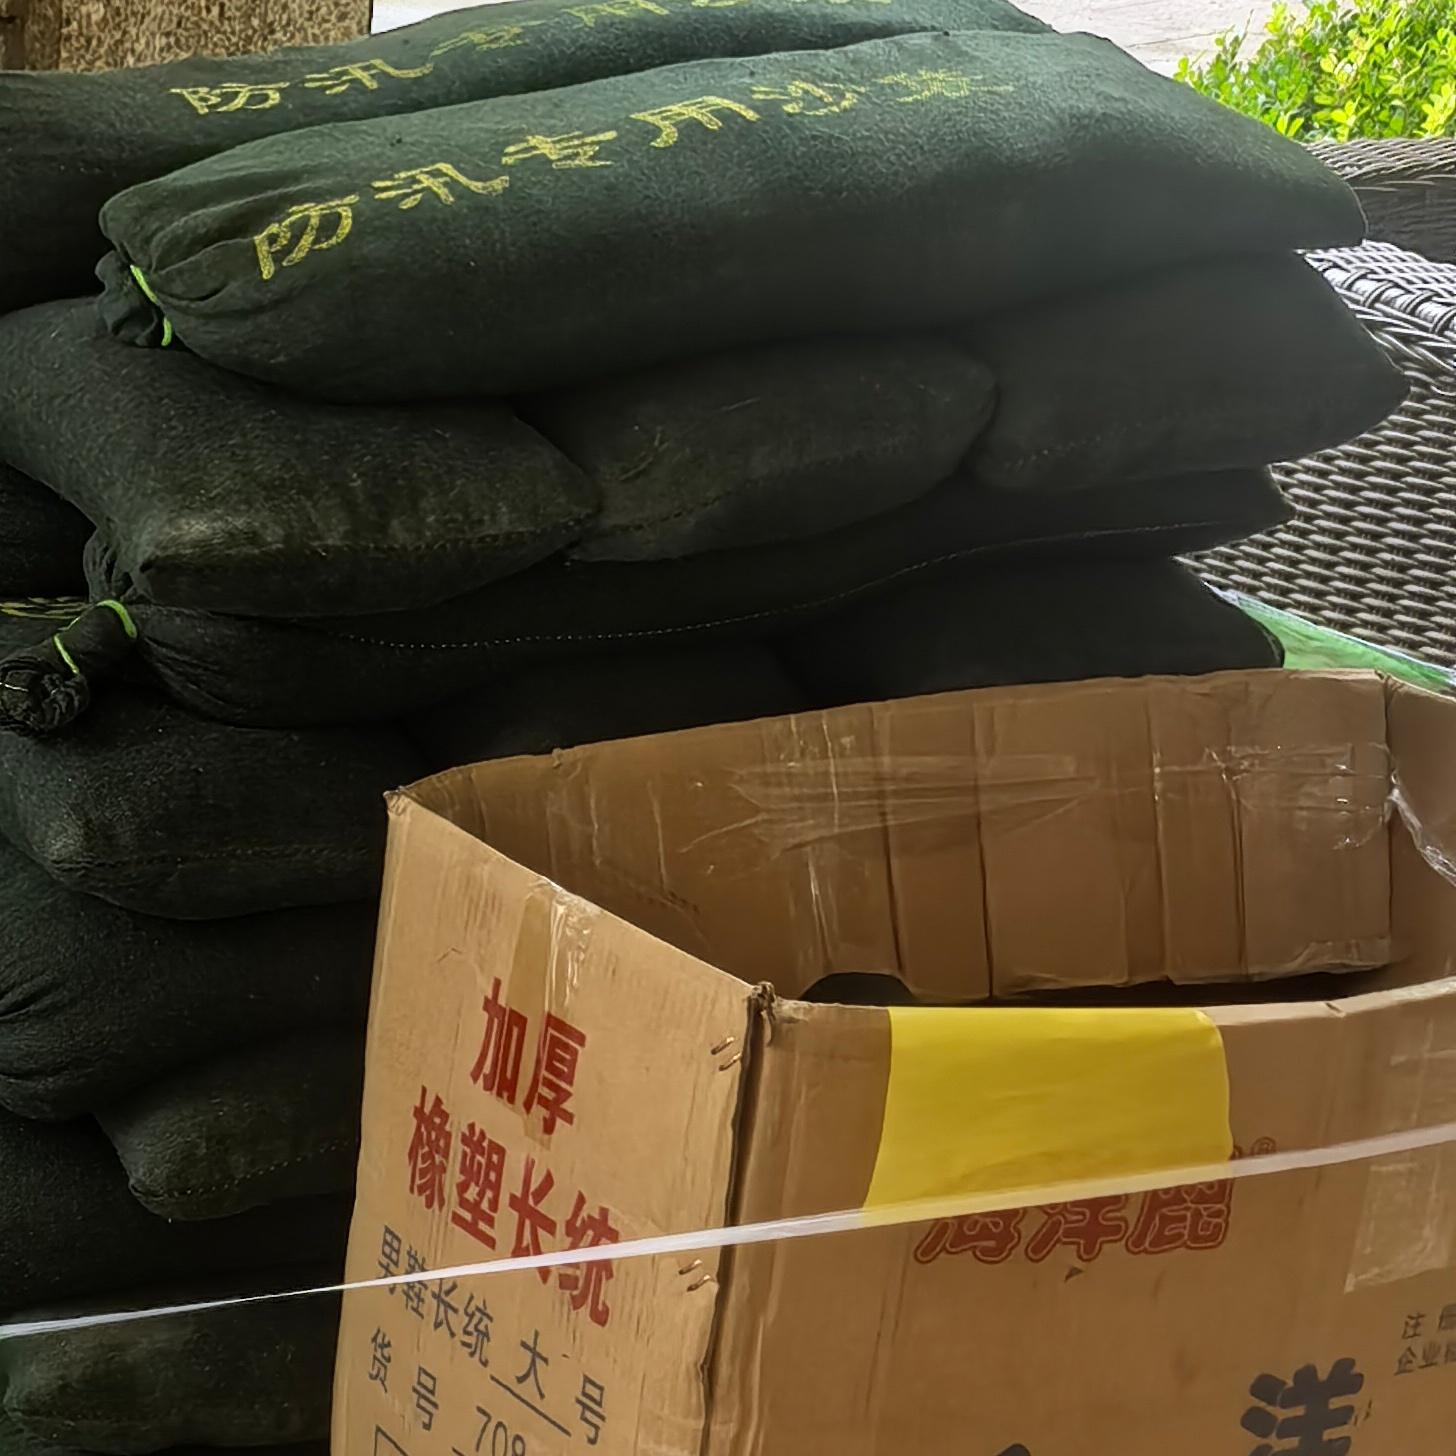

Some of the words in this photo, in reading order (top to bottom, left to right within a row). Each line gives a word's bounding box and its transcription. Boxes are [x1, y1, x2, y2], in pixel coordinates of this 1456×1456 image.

[470, 976, 587, 1137] 加厚
[408, 1085, 621, 1328] 橡塑长统
[515, 1329, 550, 1401] 大
[575, 1373, 607, 1446] 号
